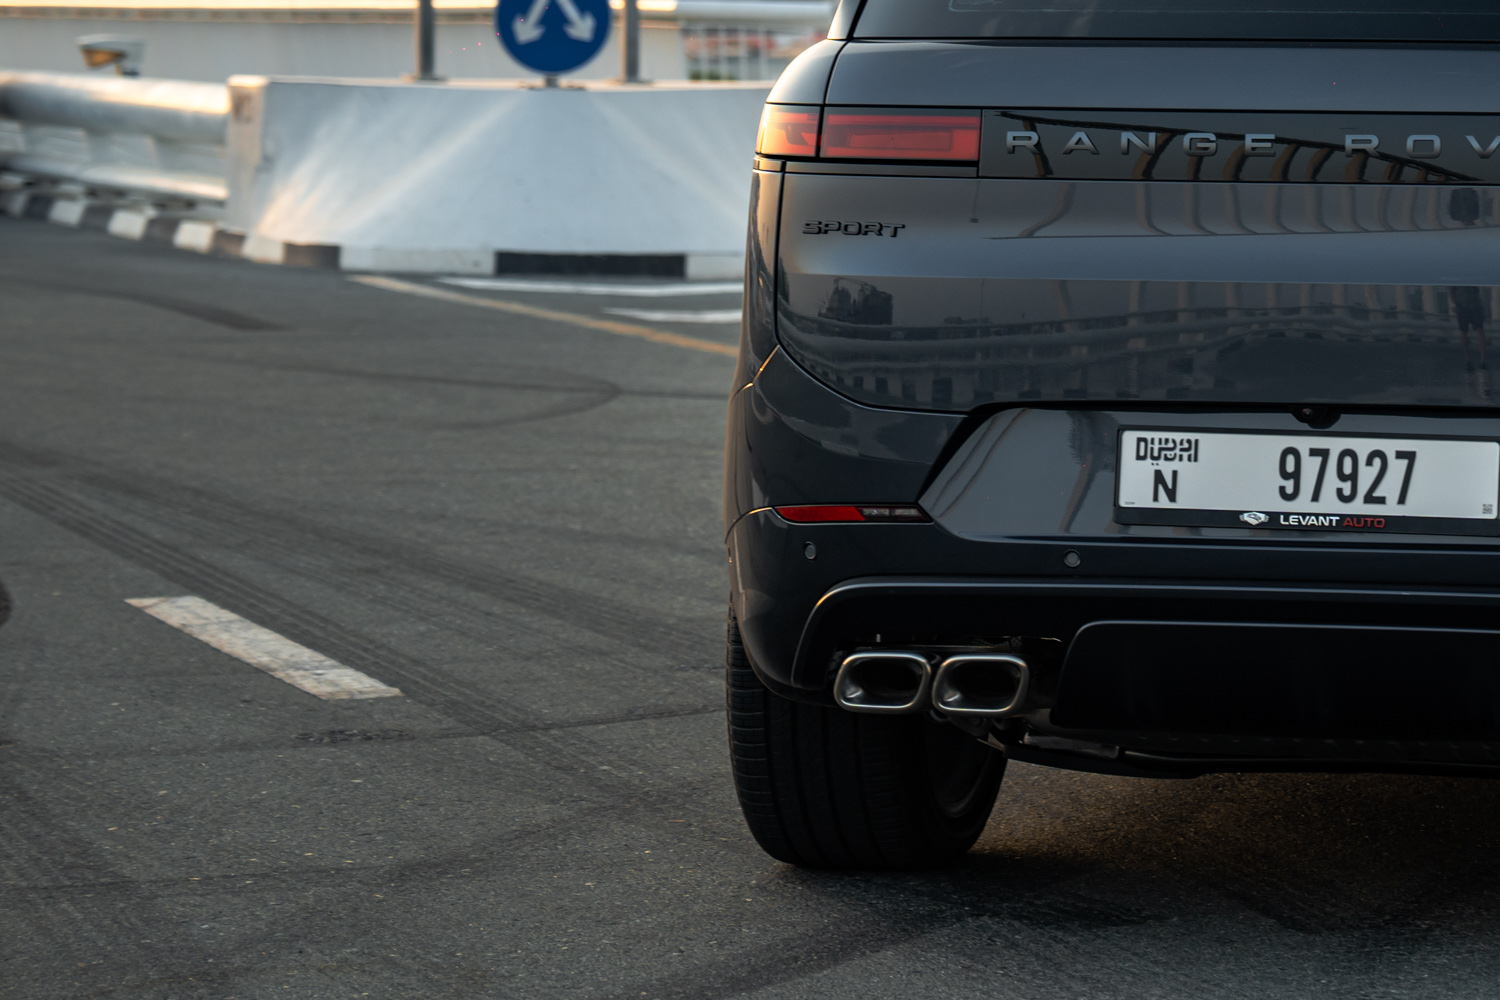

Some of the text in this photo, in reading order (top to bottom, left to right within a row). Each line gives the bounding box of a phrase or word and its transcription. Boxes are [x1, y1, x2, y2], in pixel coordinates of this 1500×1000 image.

[1006, 130, 1277, 159] RANGE
[801, 219, 906, 238] SPORT
[1152, 469, 1178, 503] N
[1278, 446, 1417, 505] 97927
[1280, 514, 1386, 528] LEVANT AUTO
